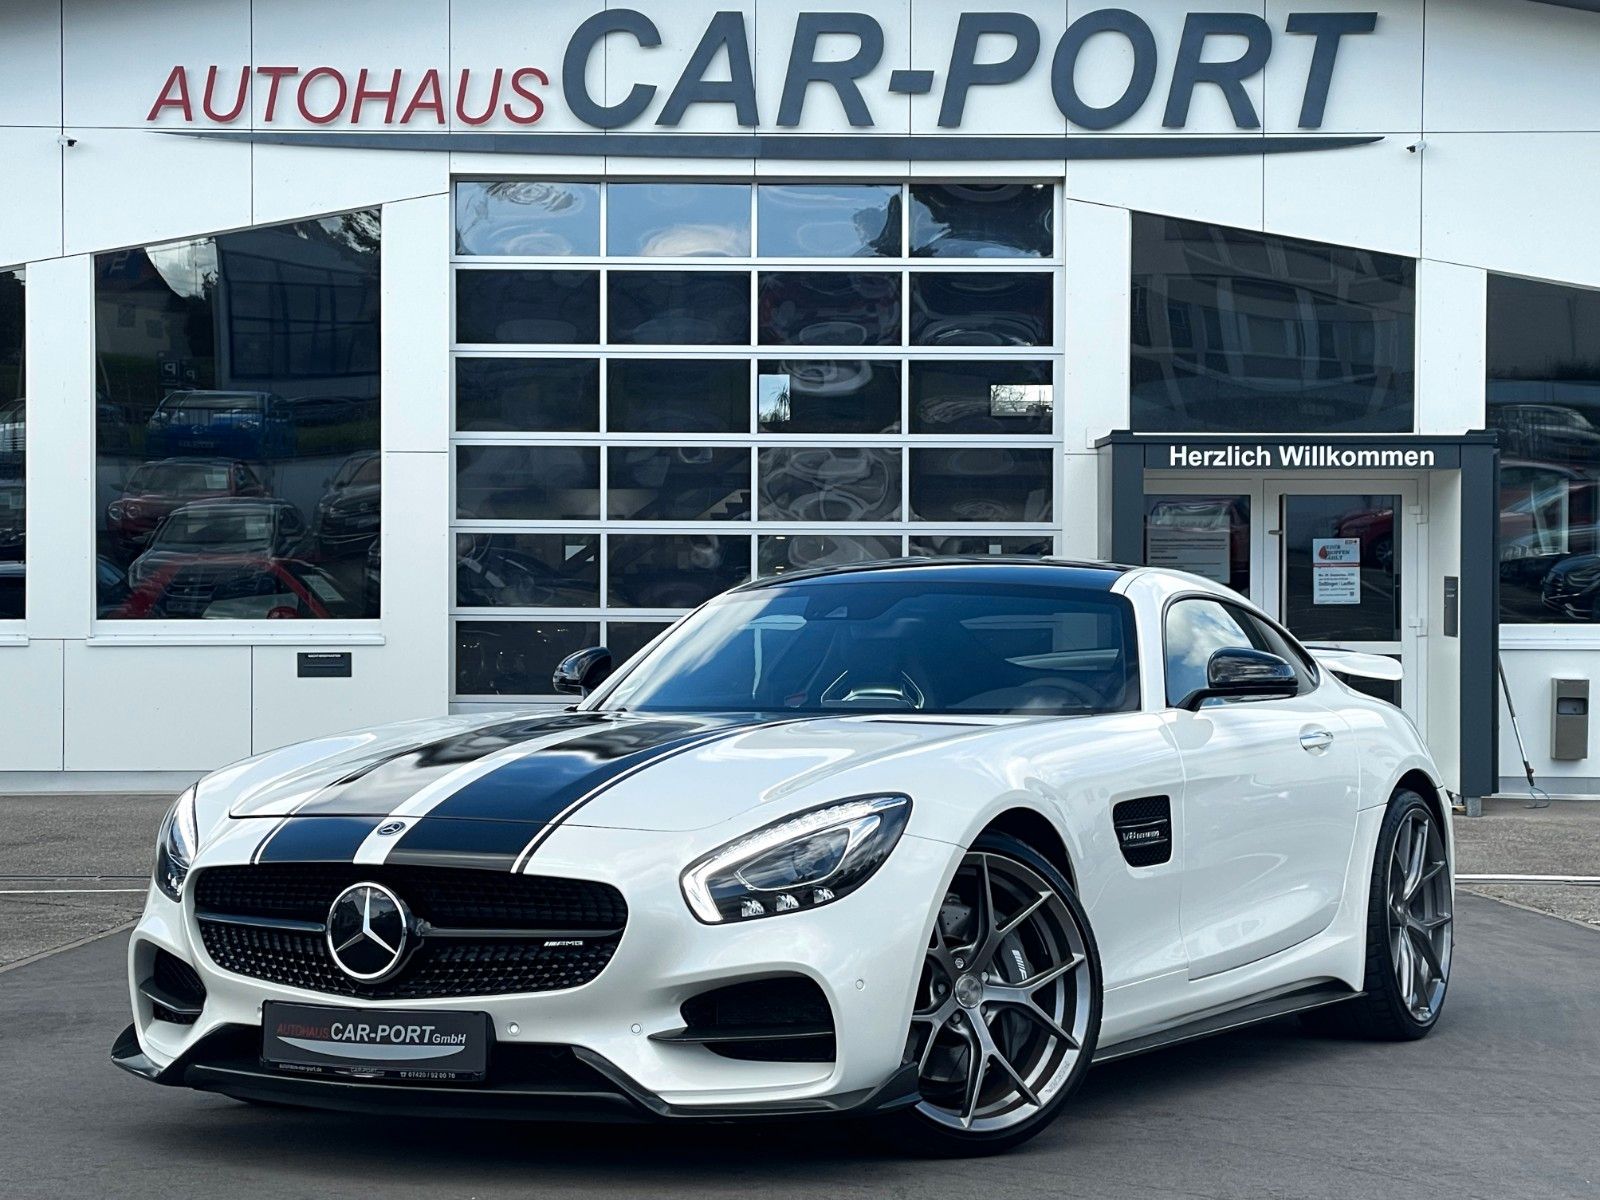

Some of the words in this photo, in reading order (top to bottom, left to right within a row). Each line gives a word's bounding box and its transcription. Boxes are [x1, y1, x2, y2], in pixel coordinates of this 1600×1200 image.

[147, 65, 550, 125] AUTOHAUS
[562, 8, 1378, 131] CAR-PORT
[1169, 445, 1271, 467] Herzlich
[1279, 445, 1436, 467] Willkommen
[277, 1024, 330, 1039] AUTOHAUS
[330, 1022, 436, 1043] CAR-PORT
[432, 1033, 467, 1044] GmbH
